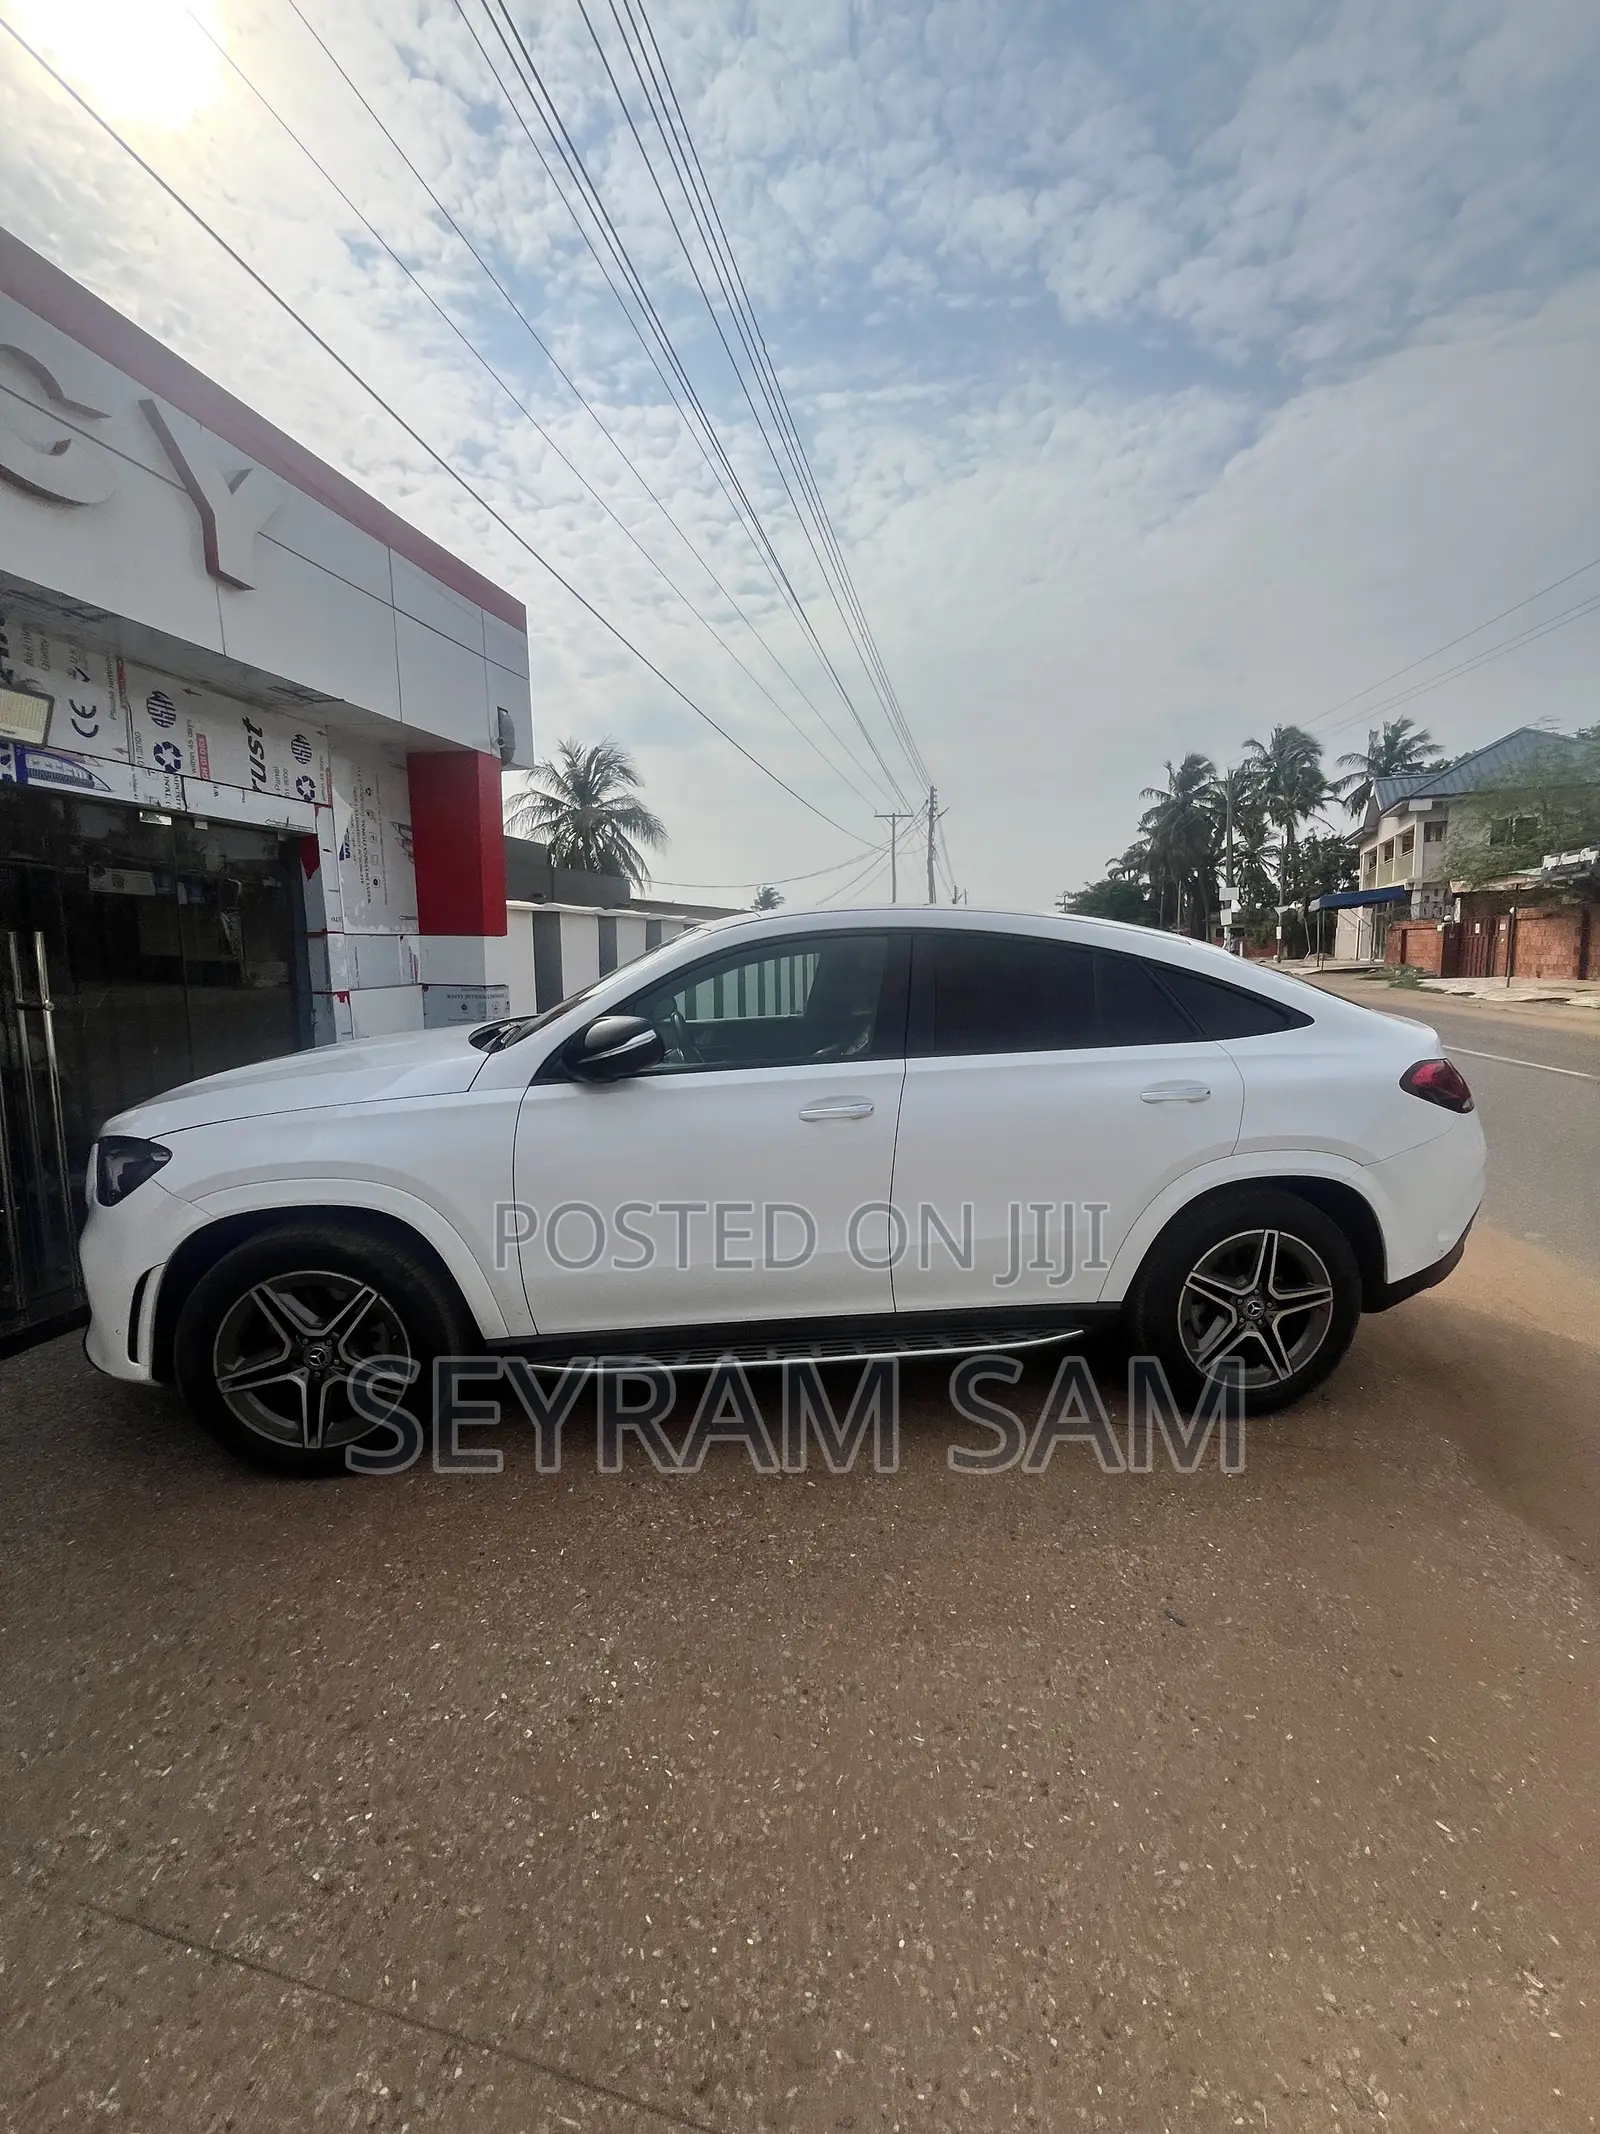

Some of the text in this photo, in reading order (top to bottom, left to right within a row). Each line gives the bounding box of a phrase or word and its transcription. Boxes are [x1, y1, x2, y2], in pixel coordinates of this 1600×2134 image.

[69, 698, 99, 738] CE
[188, 753, 197, 774] within
[198, 737, 207, 764] GLOSS
